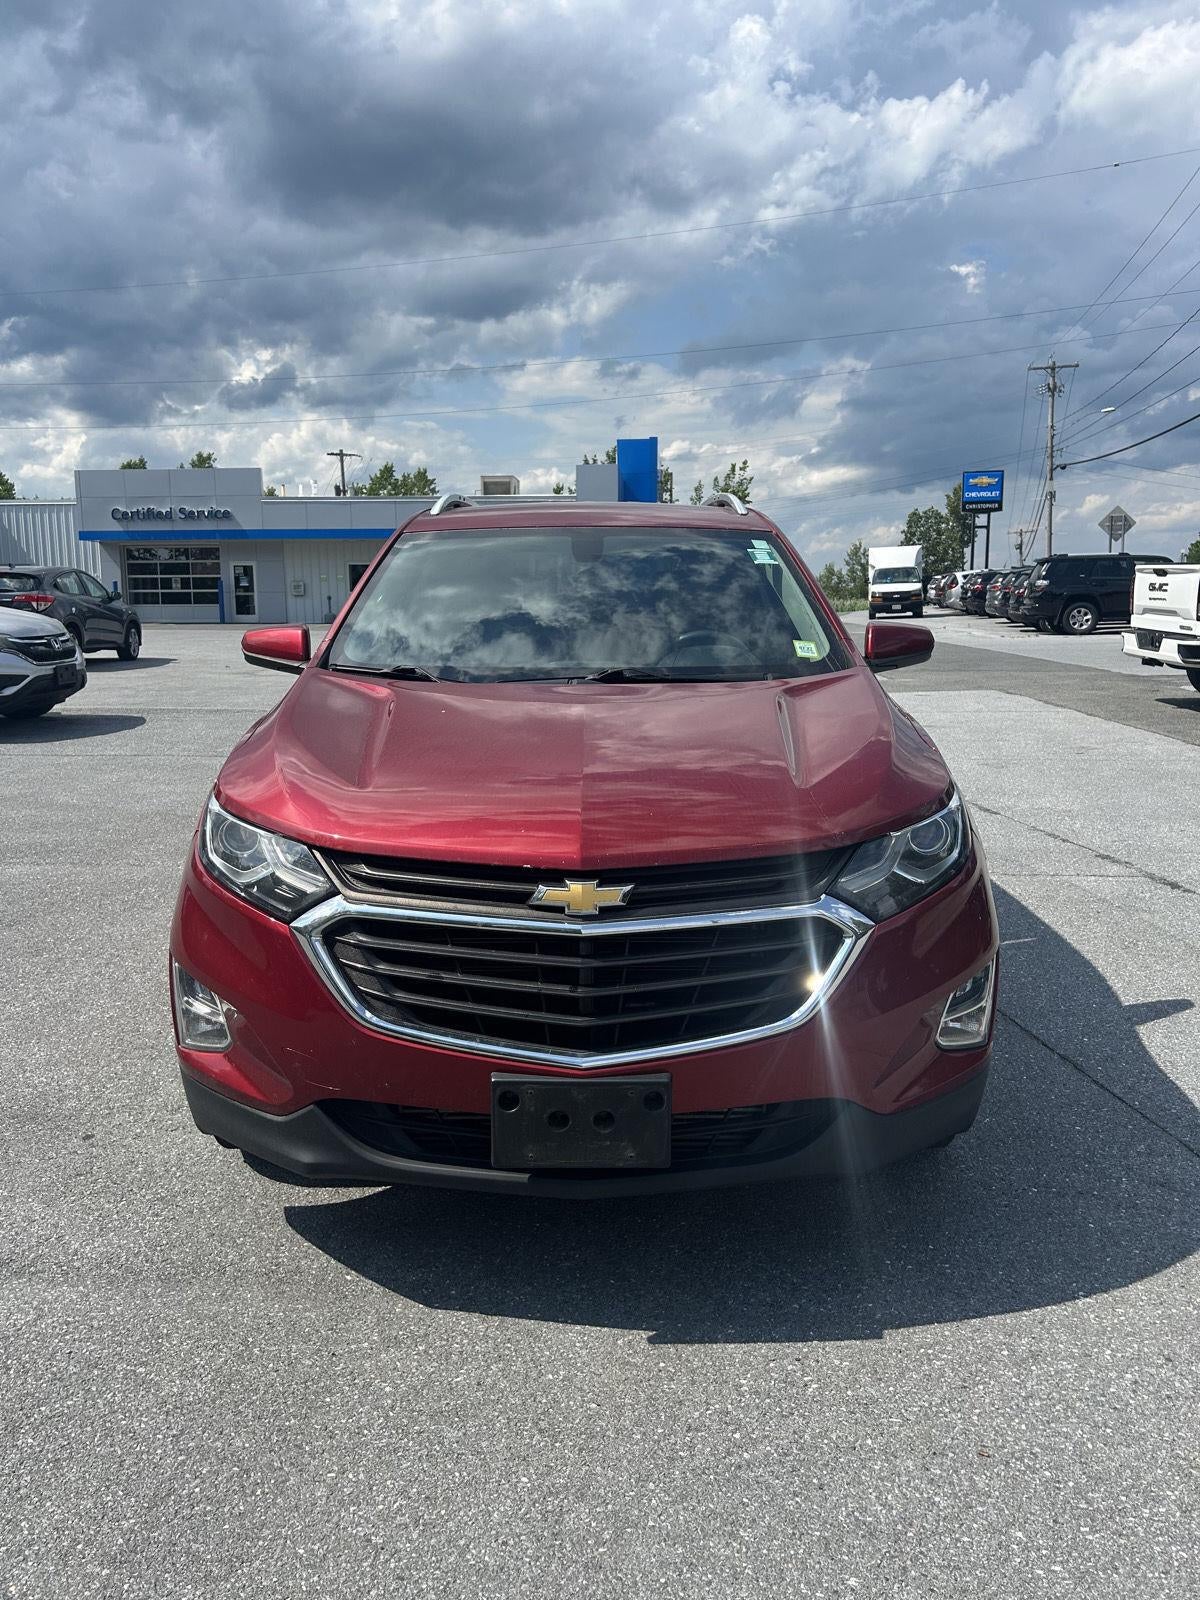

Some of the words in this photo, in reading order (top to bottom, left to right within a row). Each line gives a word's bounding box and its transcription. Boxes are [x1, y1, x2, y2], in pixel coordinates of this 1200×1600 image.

[111, 506, 173, 520] Certified
[178, 506, 231, 520] Service
[1148, 583, 1169, 592] GMC
